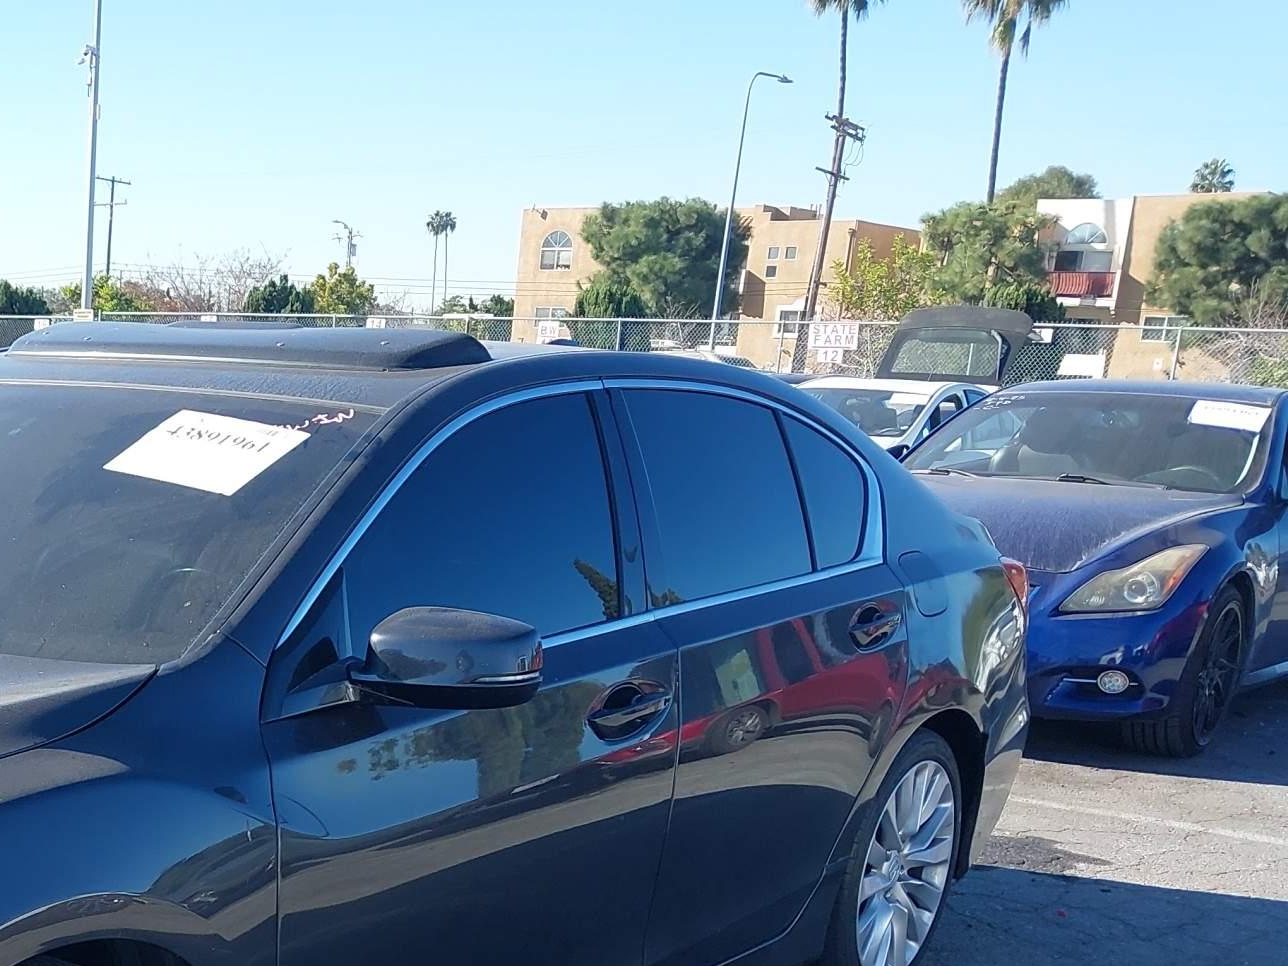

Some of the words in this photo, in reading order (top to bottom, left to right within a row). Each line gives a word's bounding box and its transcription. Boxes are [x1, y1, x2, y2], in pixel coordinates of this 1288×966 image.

[813, 324, 857, 335] STATE
[813, 335, 854, 345] FARM
[823, 350, 838, 362] 12
